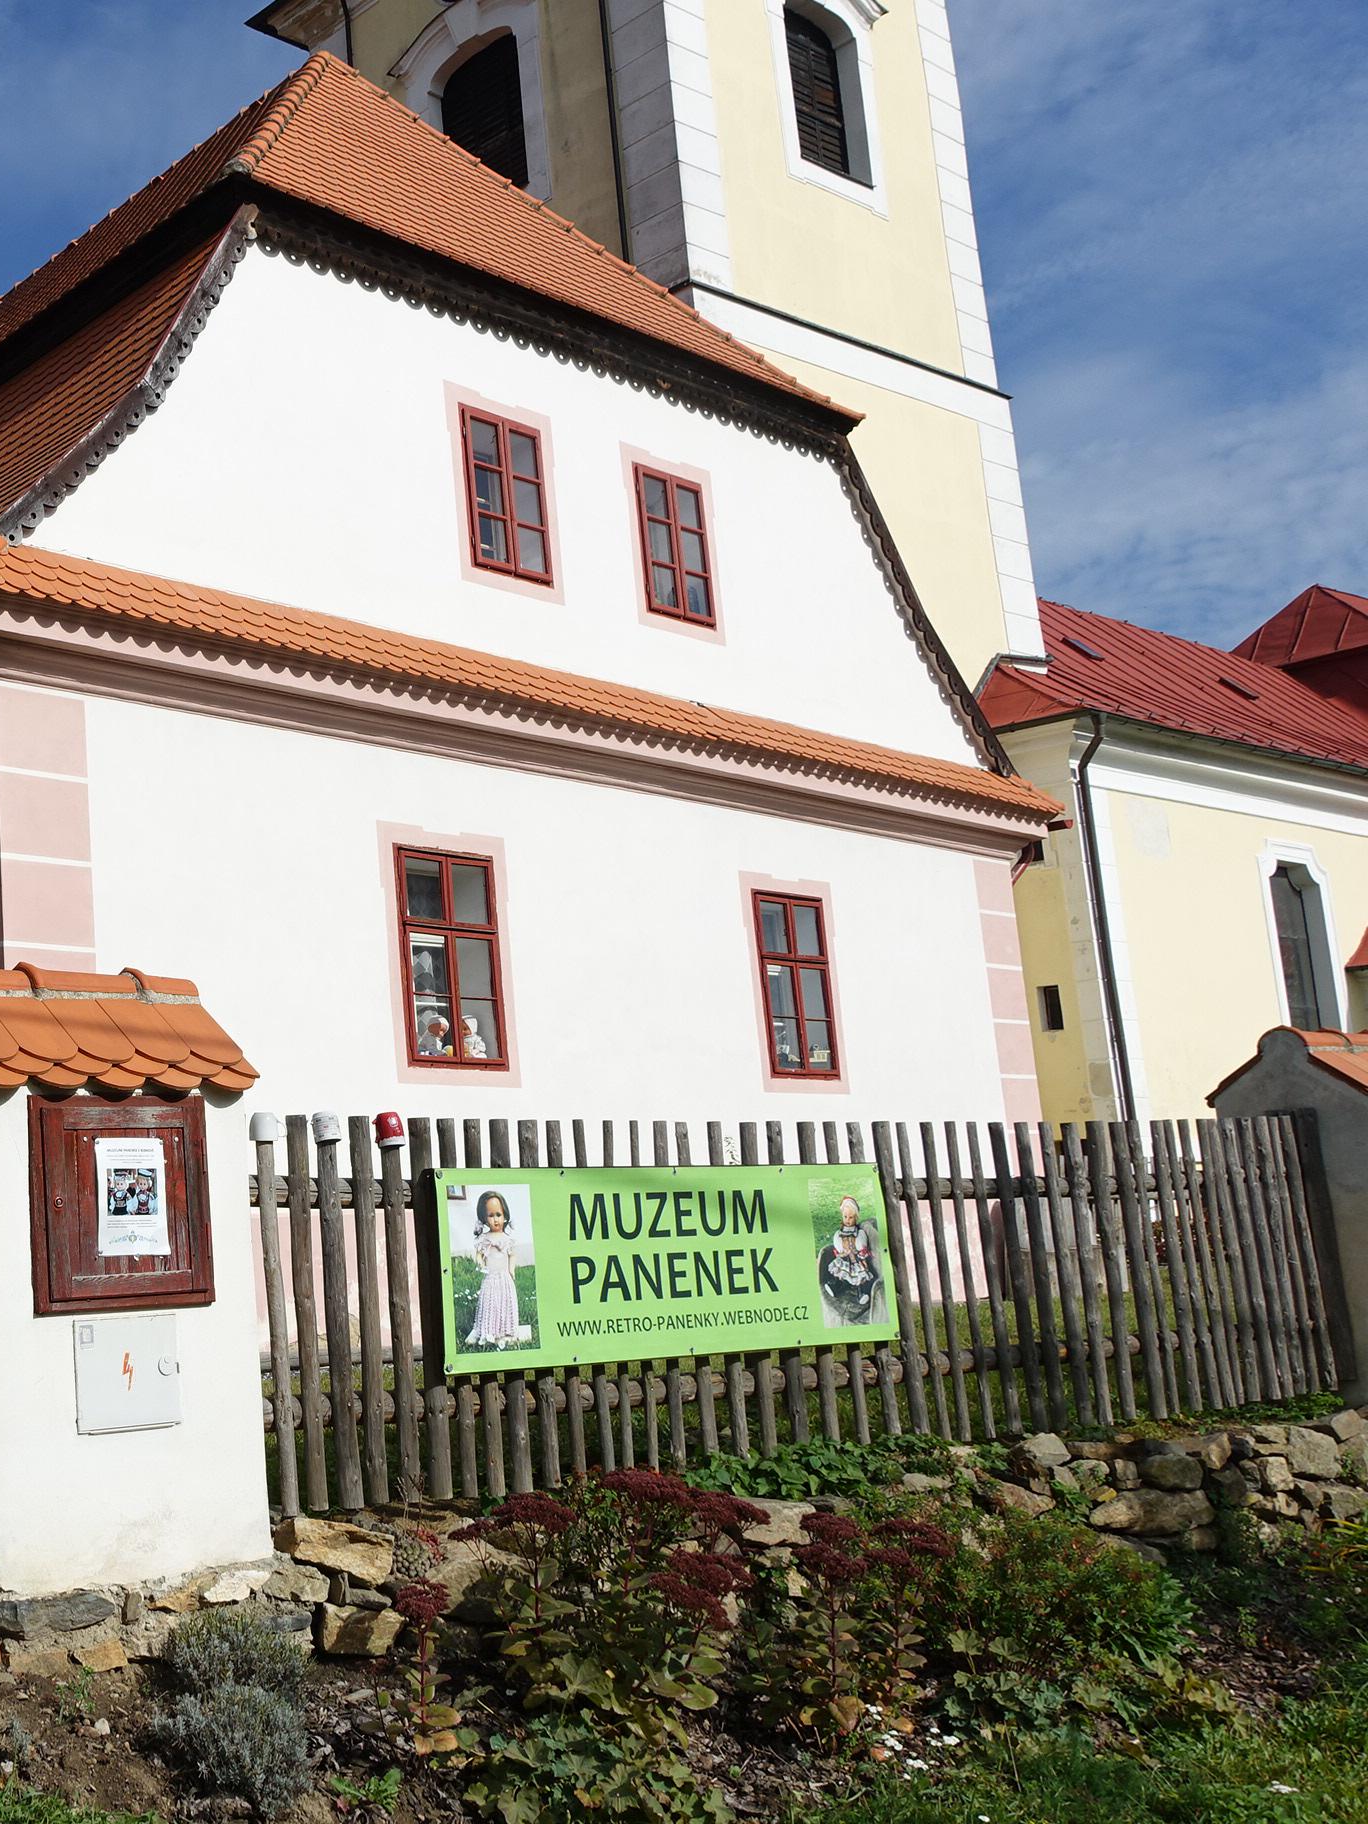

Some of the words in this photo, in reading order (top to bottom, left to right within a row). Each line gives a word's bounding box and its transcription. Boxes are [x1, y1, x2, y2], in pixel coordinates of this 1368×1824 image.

[569, 1189, 770, 1241] MUZEUM
[570, 1247, 780, 1305] PANENEK
[556, 1305, 809, 1338] WWW.RETRO-PANENKY.WEBNODE.CZ
